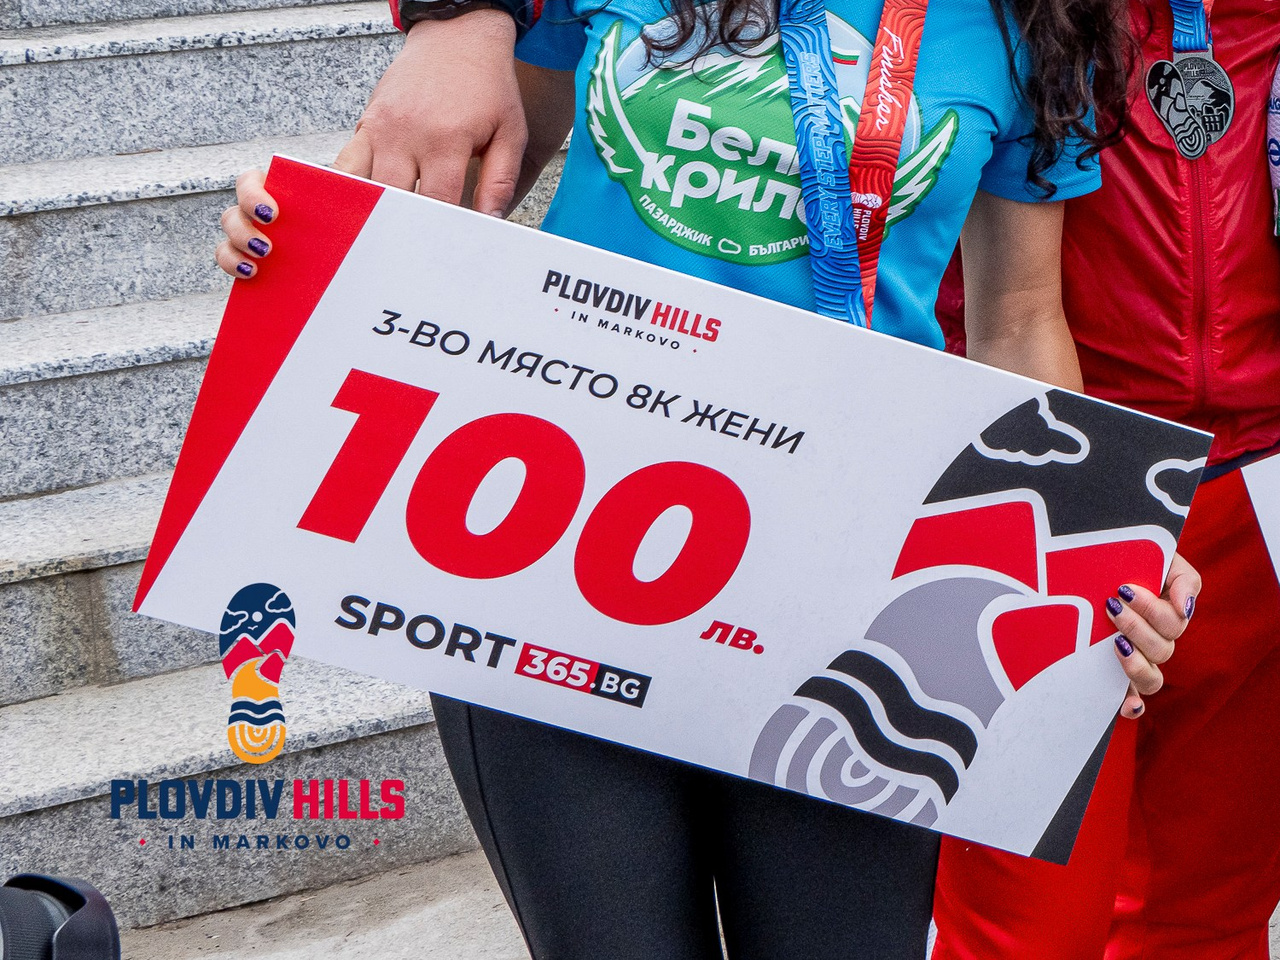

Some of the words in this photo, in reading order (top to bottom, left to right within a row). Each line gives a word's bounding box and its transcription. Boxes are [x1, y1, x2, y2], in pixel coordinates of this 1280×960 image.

[800, 50, 830, 136] MATTERS
[876, 25, 902, 132] Finisher
[640, 151, 807, 228] крил
[813, 136, 836, 187] STEP
[638, 193, 713, 247] ПАЗАРДЖИК
[748, 234, 810, 257] БЪЛГАРИ
[817, 185, 844, 250] EVERY
[858, 209, 872, 241] PLOVDIV
[541, 269, 653, 320] PLOVDIV
[650, 301, 722, 344] HILLS
[570, 310, 589, 324] IN
[597, 318, 682, 351] MARKOVO
[371, 309, 472, 357] 3-ВО
[476, 339, 619, 400] МЯСТО
[681, 399, 806, 455] ЖЕНИ
[294, 367, 752, 627] 100
